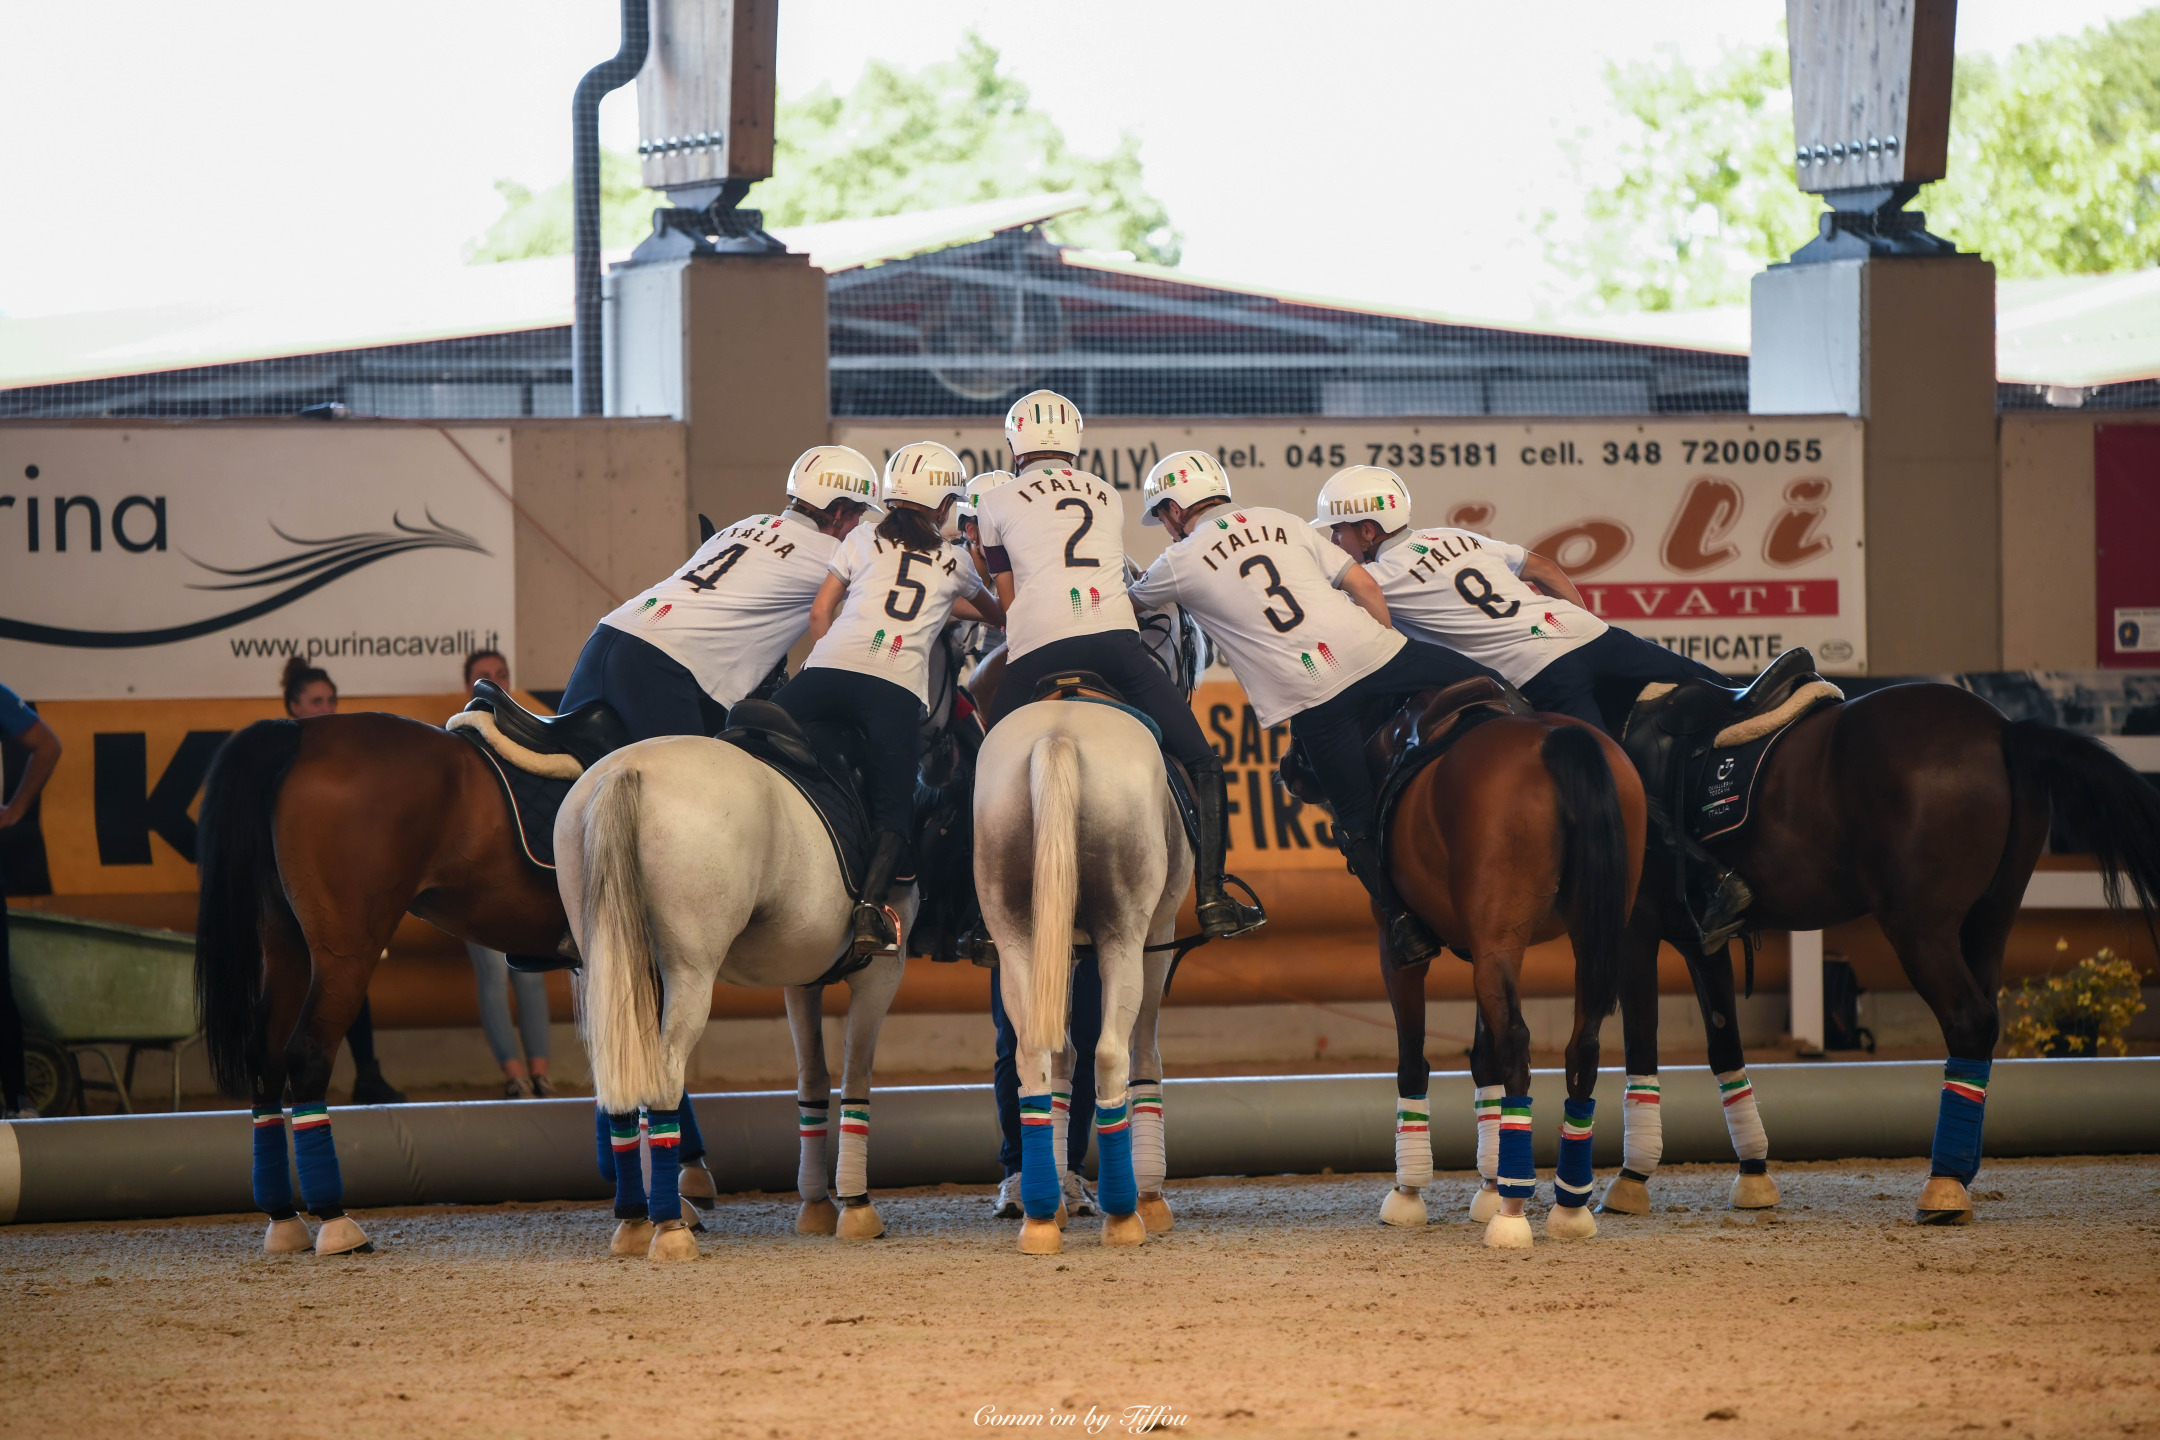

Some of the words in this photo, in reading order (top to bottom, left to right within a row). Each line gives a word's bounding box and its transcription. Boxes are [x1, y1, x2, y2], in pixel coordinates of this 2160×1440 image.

[1217, 445, 1265, 467] tel.
[1286, 444, 1347, 467] 045
[1366, 443, 1498, 467] 7335181
[1520, 441, 1584, 465] cell.
[1603, 441, 1662, 465] 348
[1682, 439, 1823, 464] 7200055
[818, 472, 867, 495] ITALIA
[1017, 479, 1108, 506] ITALIA
[1330, 497, 1381, 516] ITALIA
[715, 527, 796, 560] ITALIA
[1055, 497, 1101, 568] 2
[1202, 525, 1288, 572] ITALIA
[680, 543, 750, 594] 4
[1408, 535, 1483, 584] ITALIA
[884, 550, 933, 622] 5
[1239, 554, 1305, 634] 3
[1454, 568, 1521, 619] 8
[1708, 805, 1730, 818] ITALIA
